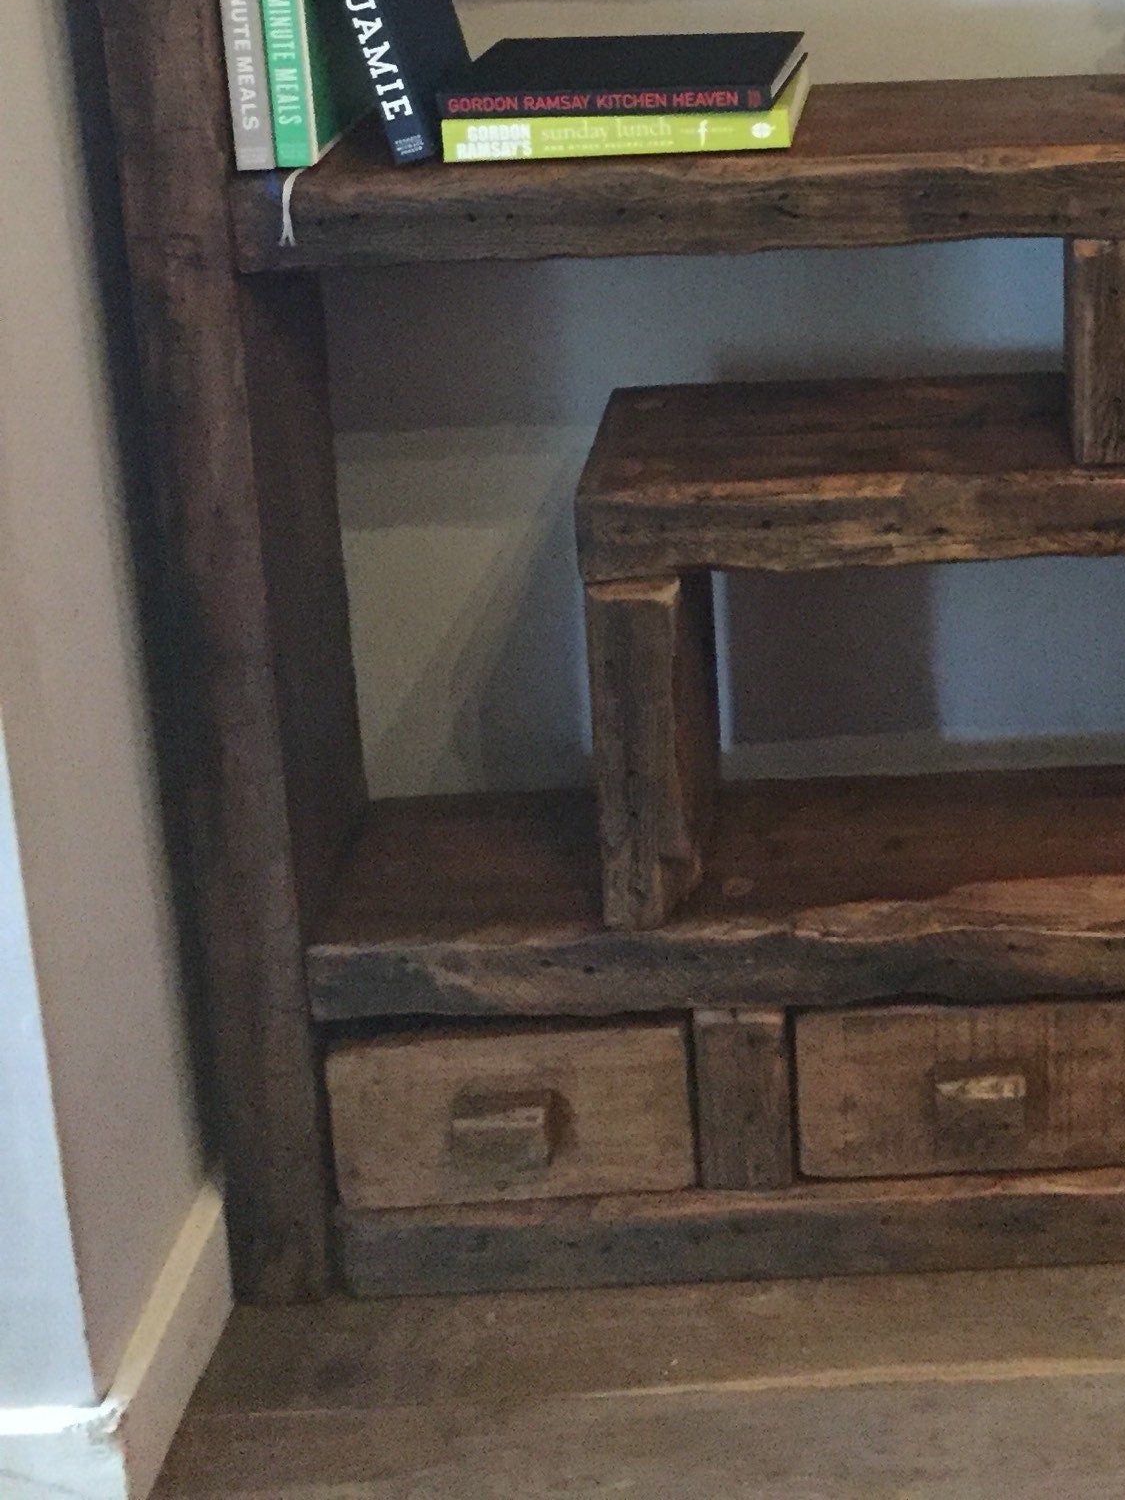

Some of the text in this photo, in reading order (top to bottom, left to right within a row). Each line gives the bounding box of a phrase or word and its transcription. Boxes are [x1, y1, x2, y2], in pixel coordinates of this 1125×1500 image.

[234, 54, 260, 131] MEALS
[277, 67, 303, 126] MEALS
[448, 97, 518, 114] GORDON
[523, 95, 590, 112] RAMSAY
[597, 94, 666, 110] KITCHEN
[673, 92, 740, 108] HEAVEN
[467, 123, 532, 142] GORDON
[540, 117, 673, 144] sunday lunch
[456, 141, 533, 159] RAMSAY'S
